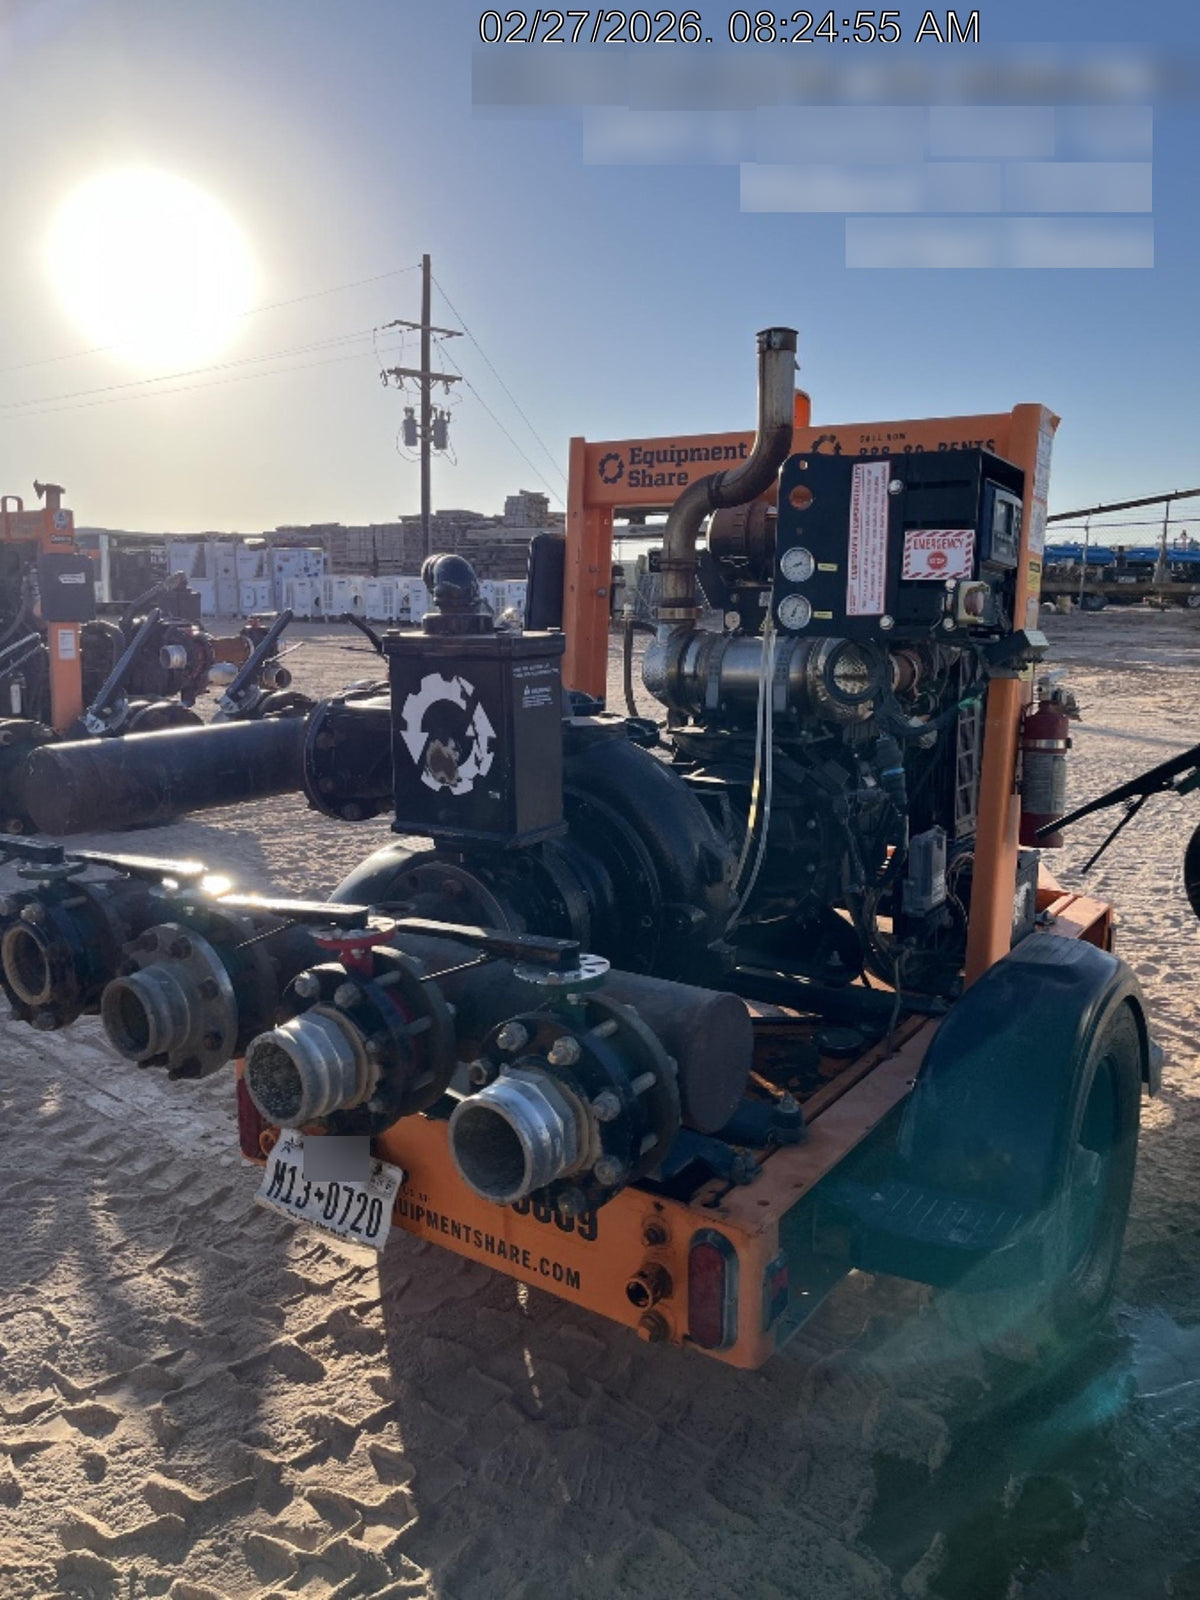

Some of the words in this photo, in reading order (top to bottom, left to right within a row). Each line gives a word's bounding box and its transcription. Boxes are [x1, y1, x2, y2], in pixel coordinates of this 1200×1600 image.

[629, 442, 747, 468] Equipment
[628, 469, 689, 487] Share
[913, 537, 964, 550] EMERGENCY
[393, 1198, 581, 1290] UIPMENTSHARE.COM
